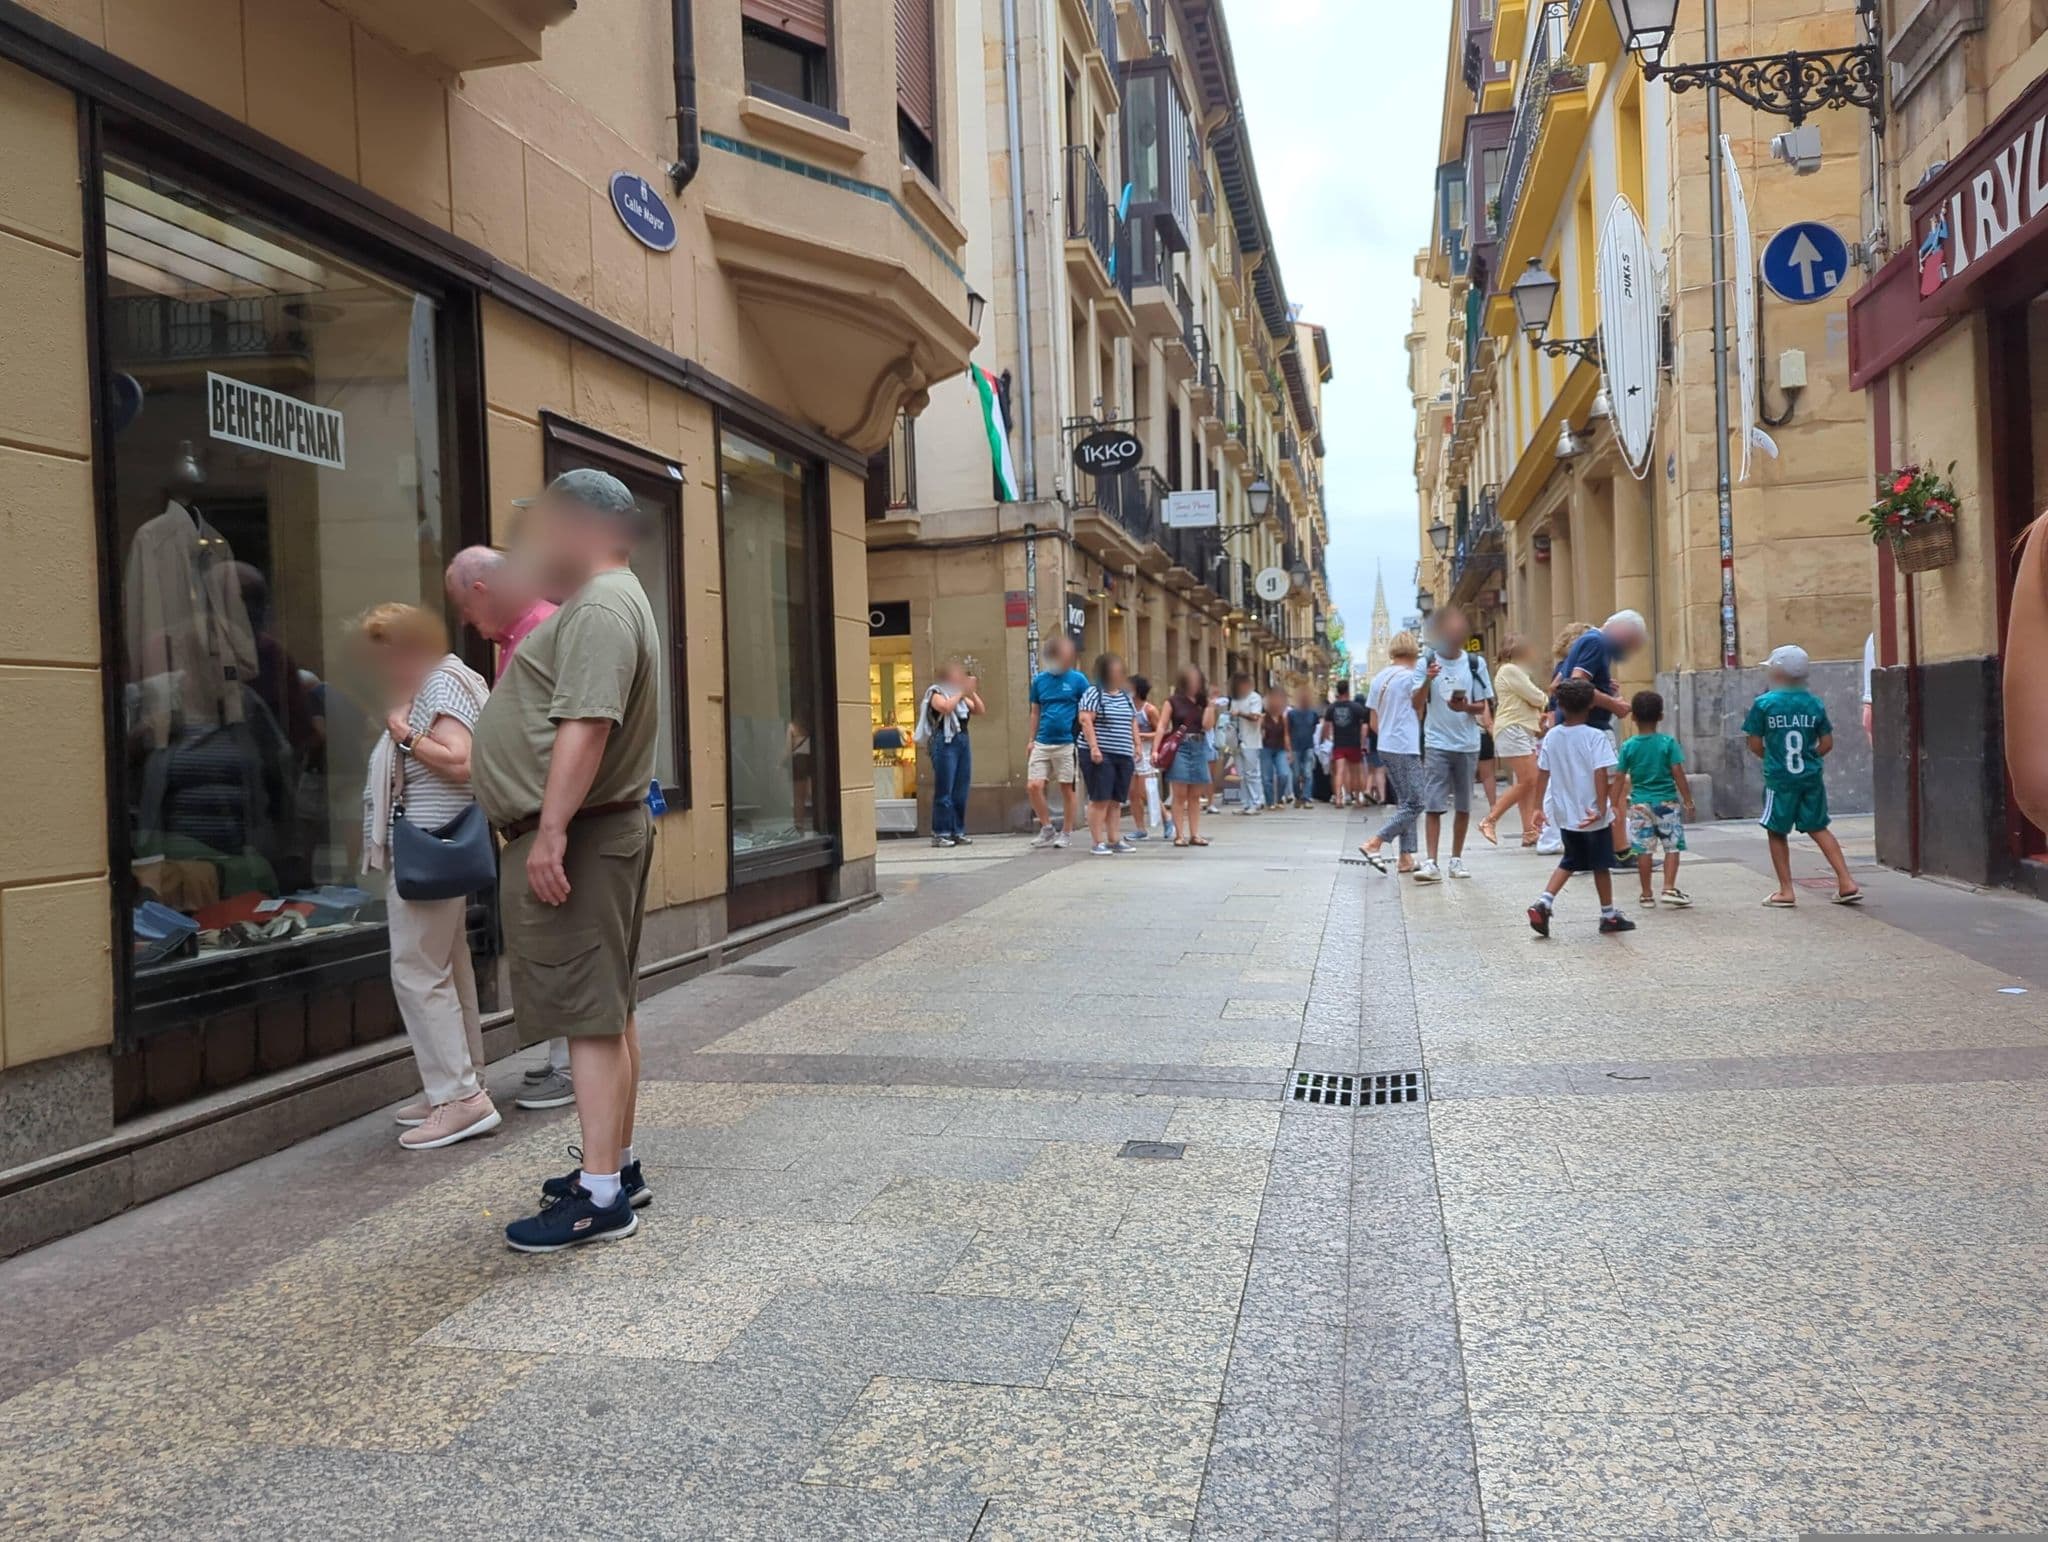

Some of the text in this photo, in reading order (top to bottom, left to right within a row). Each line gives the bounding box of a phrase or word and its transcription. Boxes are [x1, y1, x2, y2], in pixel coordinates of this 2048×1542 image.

[624, 193, 665, 232] Calle Mayor
[212, 379, 342, 463] BEHERAPENAK
[1785, 730, 1805, 774] 8
